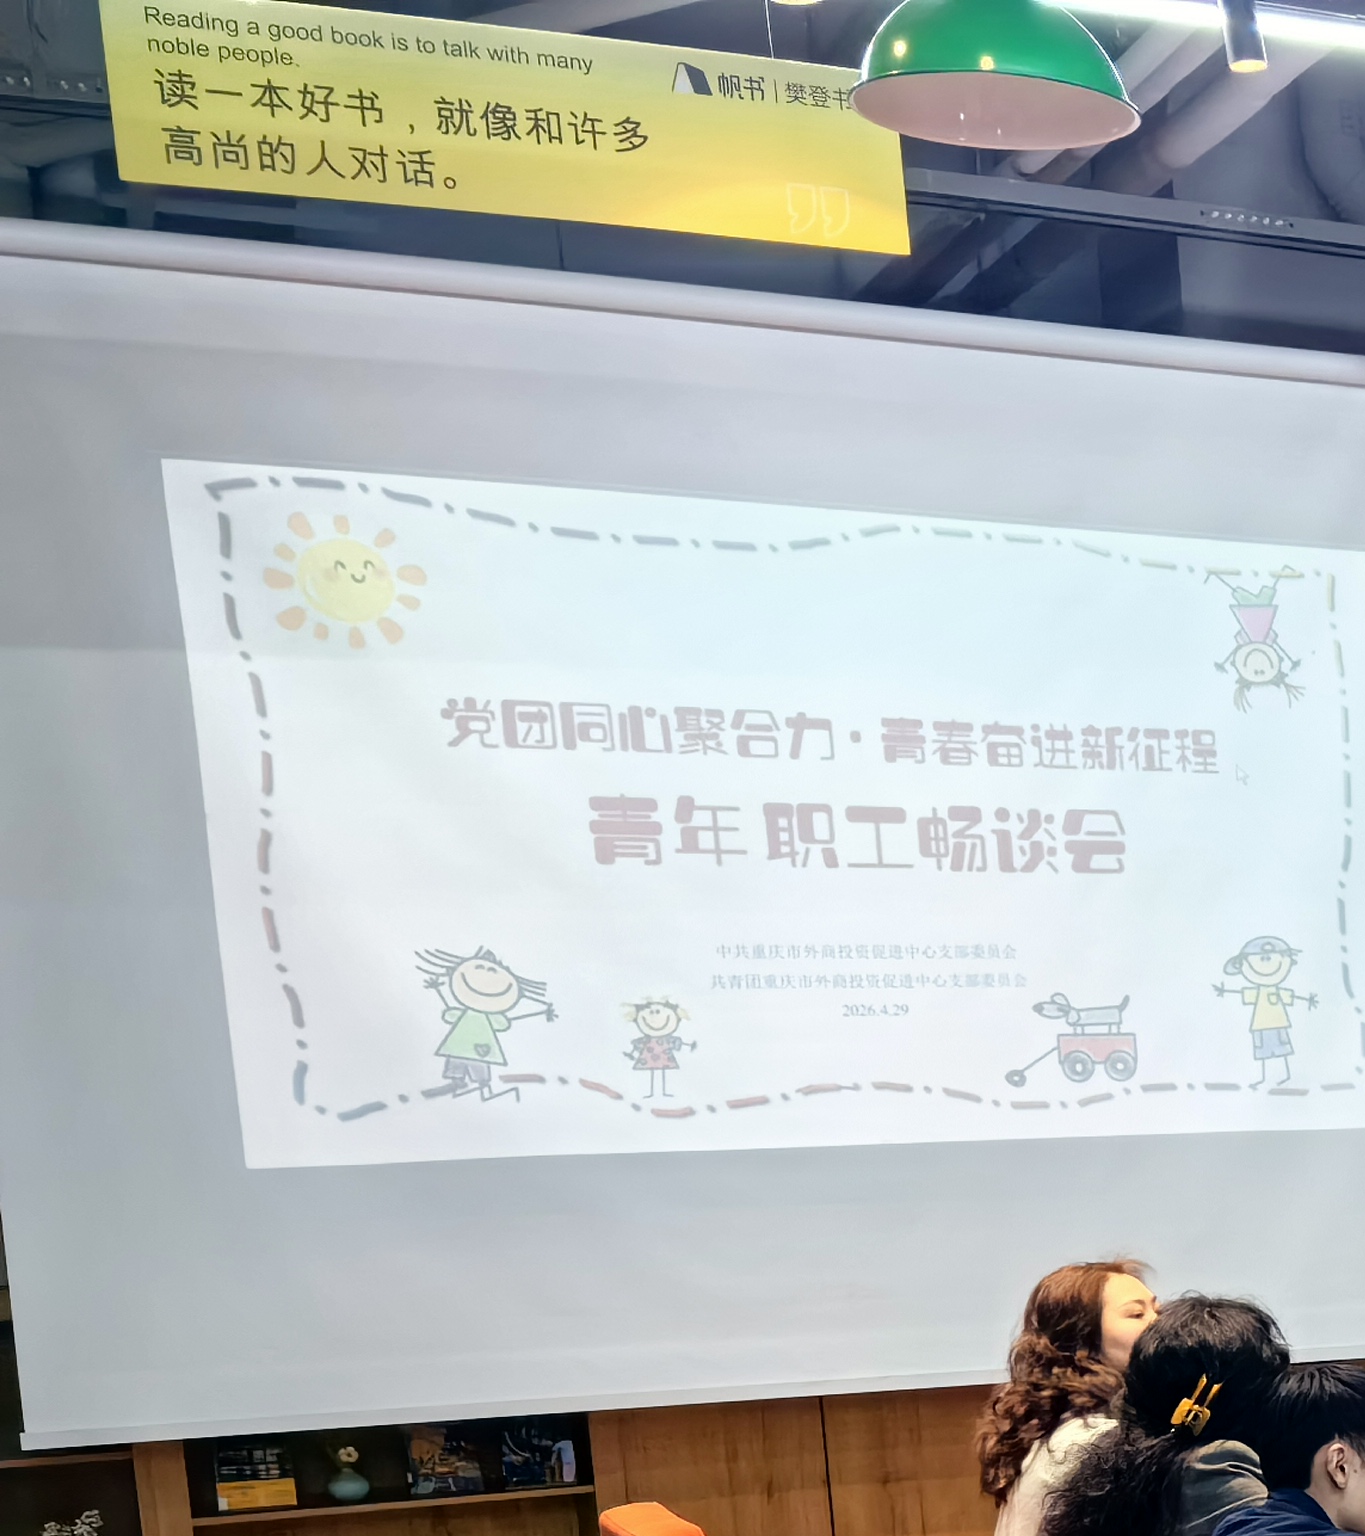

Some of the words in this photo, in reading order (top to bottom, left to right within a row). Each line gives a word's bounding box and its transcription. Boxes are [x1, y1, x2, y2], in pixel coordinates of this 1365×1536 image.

[144, 6, 239, 37] Reading
[247, 22, 260, 36] a
[268, 25, 323, 41] good
[331, 26, 384, 48] book
[391, 33, 409, 51] is
[416, 36, 436, 54] to
[443, 39, 481, 60] talk
[486, 45, 529, 65] with
[537, 52, 593, 75] many
[148, 37, 210, 58] noble
[218, 45, 300, 67] people.
[153, 68, 649, 152] 读一本好书，就像和许多
[718, 73, 764, 101] 帆书
[161, 126, 456, 189] 高尚的人对话。
[439, 696, 1221, 776] 党团同心聚合力·青春奋进新征程
[588, 793, 1126, 874] 青年职工畅谈会
[842, 1004, 909, 1017] 2026.4.29
